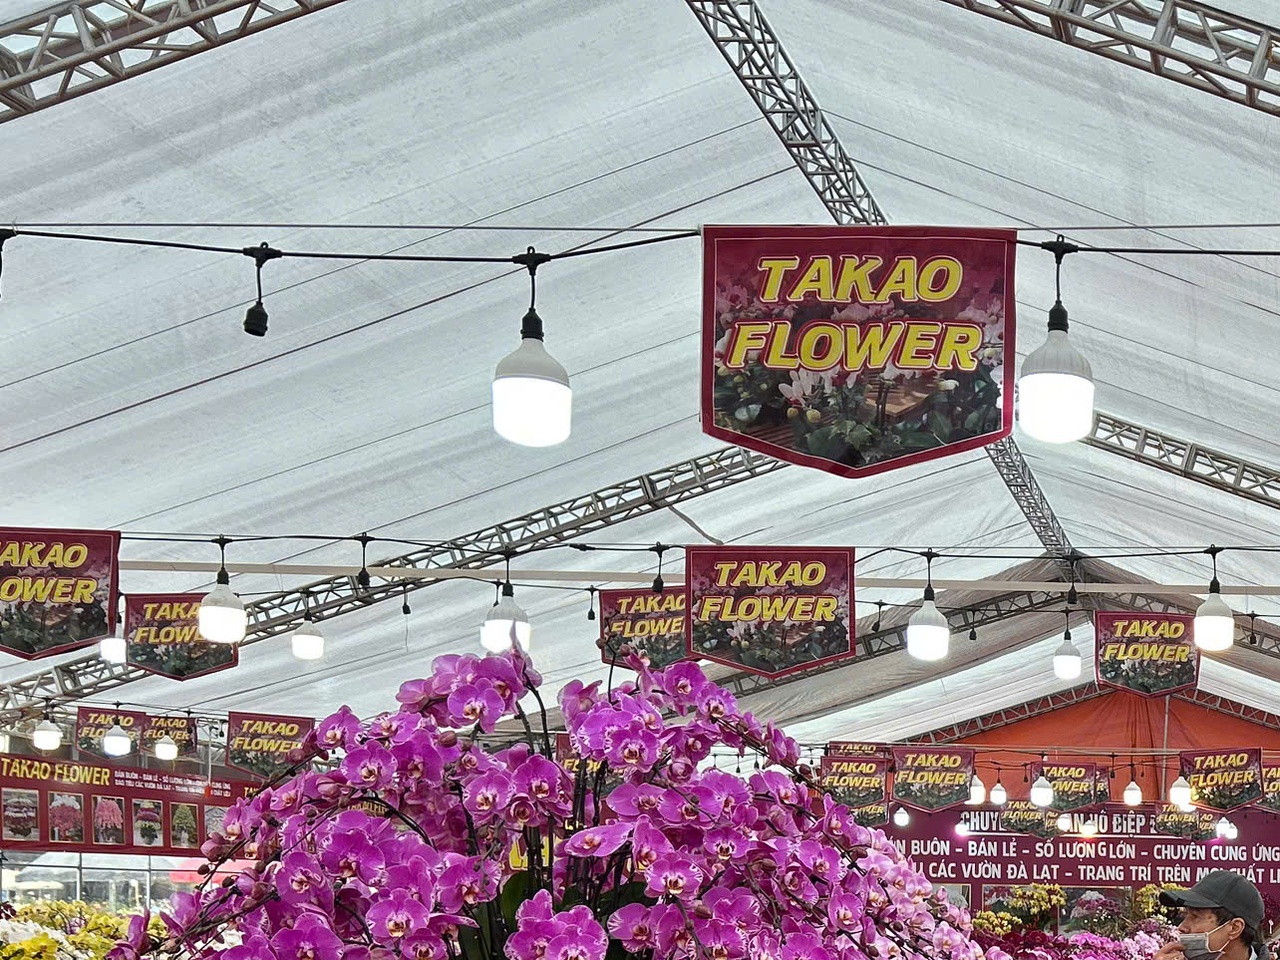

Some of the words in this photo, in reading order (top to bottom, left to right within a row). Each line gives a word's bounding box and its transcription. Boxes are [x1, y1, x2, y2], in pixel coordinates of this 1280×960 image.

[757, 254, 963, 304] TAKAO
[726, 320, 984, 372] FLOWER
[0, 541, 88, 568] AKAO
[715, 561, 828, 587] TAKAO
[0, 576, 98, 604] OWER
[143, 602, 200, 621] TAKA
[699, 596, 839, 622] FLOWER
[134, 626, 205, 644] FLOW
[611, 617, 686, 638] FLOWE
[1113, 620, 1185, 638] TAKAO
[1103, 643, 1190, 662] FLOWER
[242, 720, 299, 736] TAKAO
[831, 762, 877, 773] TAKAO
[905, 754, 961, 768] TAKAO
[1194, 753, 1249, 770] TAKAO
[1, 758, 51, 780] TAKAO
[54, 764, 110, 786] FLOWER
[897, 770, 967, 785] FLOWER
[1190, 770, 1254, 787] FLOWER
[825, 776, 881, 788] FLOWER
[1051, 781, 1089, 792] OWER
[961, 811, 1007, 831] CHUY
[1002, 811, 1042, 820] FLOWER
[1157, 814, 1195, 822] FLOWER
[911, 837, 950, 856] BUÔN
[968, 837, 998, 857] BÁN
[1003, 837, 1017, 857] LẺ
[1035, 837, 1053, 858] SỐ
[1109, 840, 1136, 859] LỚN
[1153, 839, 1206, 861] CHUYÊN
[1210, 844, 1247, 861] CUNG
[1252, 841, 1280, 862] ỨNG
[928, 859, 956, 878] CÁC
[961, 860, 1001, 879] VƯỜN
[1007, 859, 1028, 879] ĐÀ
[1033, 864, 1059, 885] LẠT
[1078, 865, 1124, 881] TRANG
[1130, 863, 1152, 881] TRÍ
[1157, 864, 1190, 882] TRÊN
